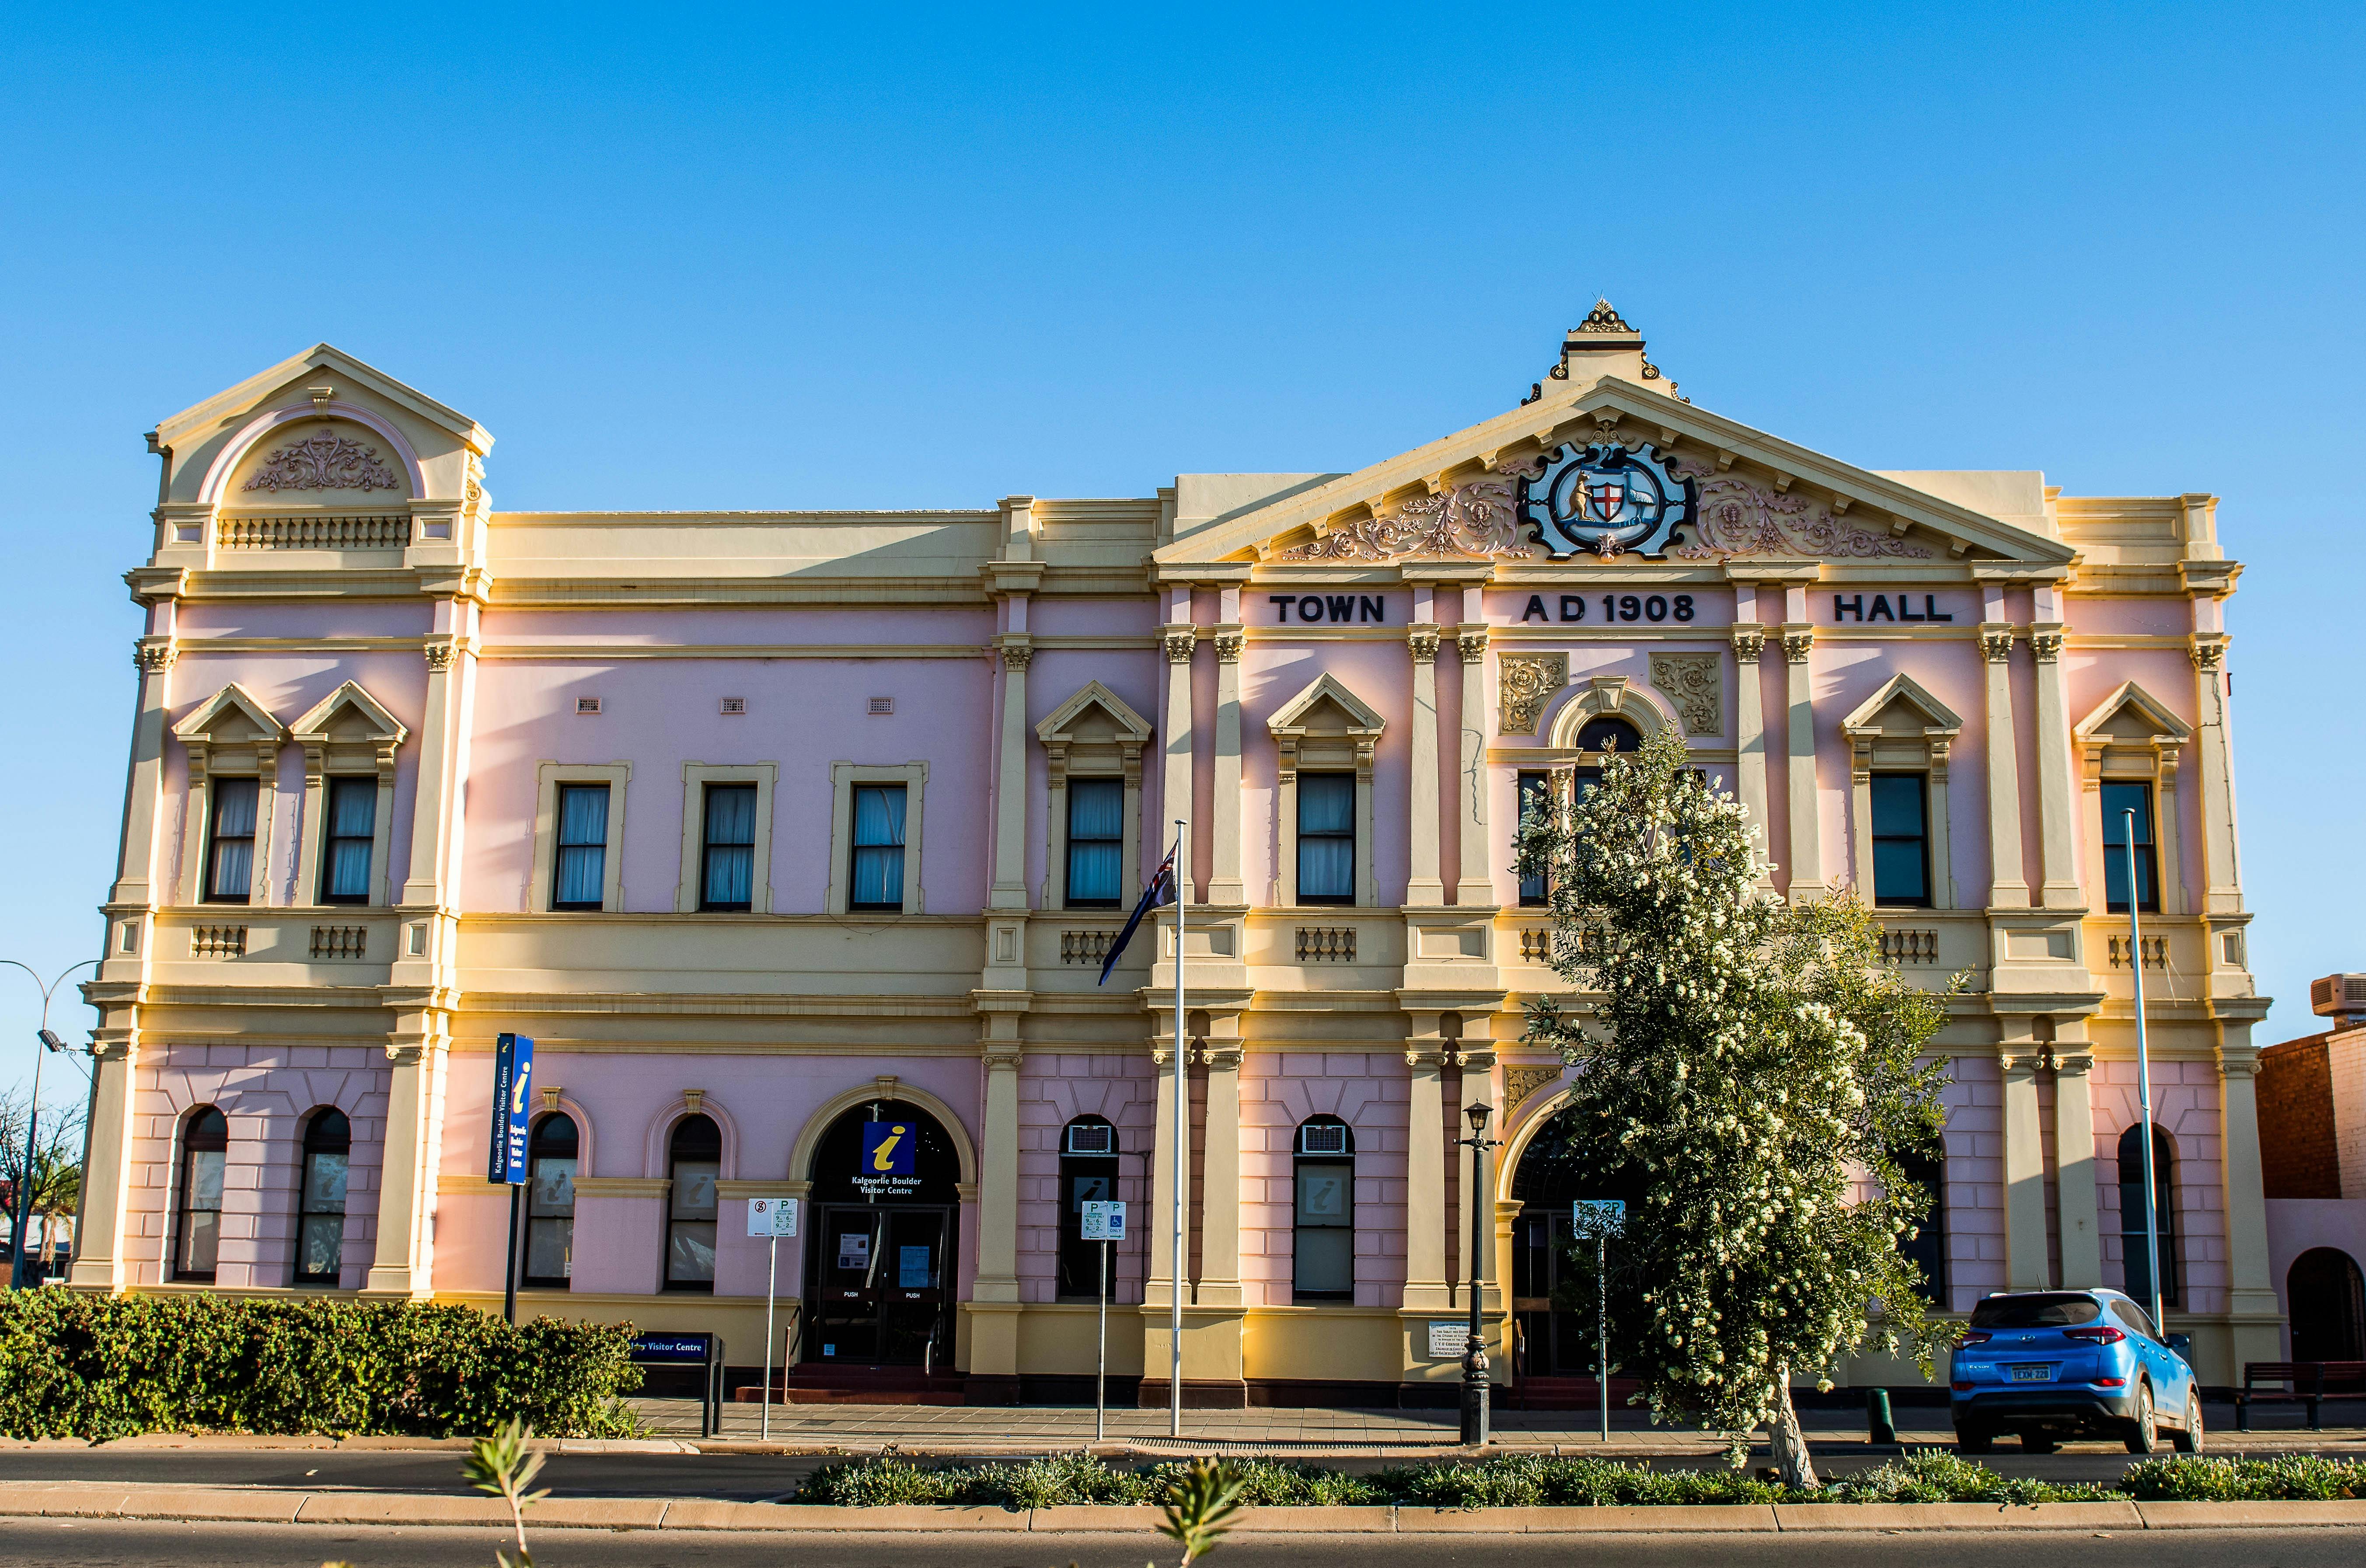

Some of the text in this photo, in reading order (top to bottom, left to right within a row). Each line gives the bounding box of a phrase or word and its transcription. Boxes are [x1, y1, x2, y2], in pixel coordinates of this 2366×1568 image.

[1270, 596, 1383, 622] TOWN
[1603, 595, 1694, 622] 1908
[1834, 595, 1952, 621] HALL
[495, 1140, 503, 1173] Kalgoorlie
[852, 1177, 890, 1186] Kalgoorlie
[781, 1200, 789, 1209] P
[1091, 1203, 1098, 1212] P
[1113, 1203, 1120, 1212] P
